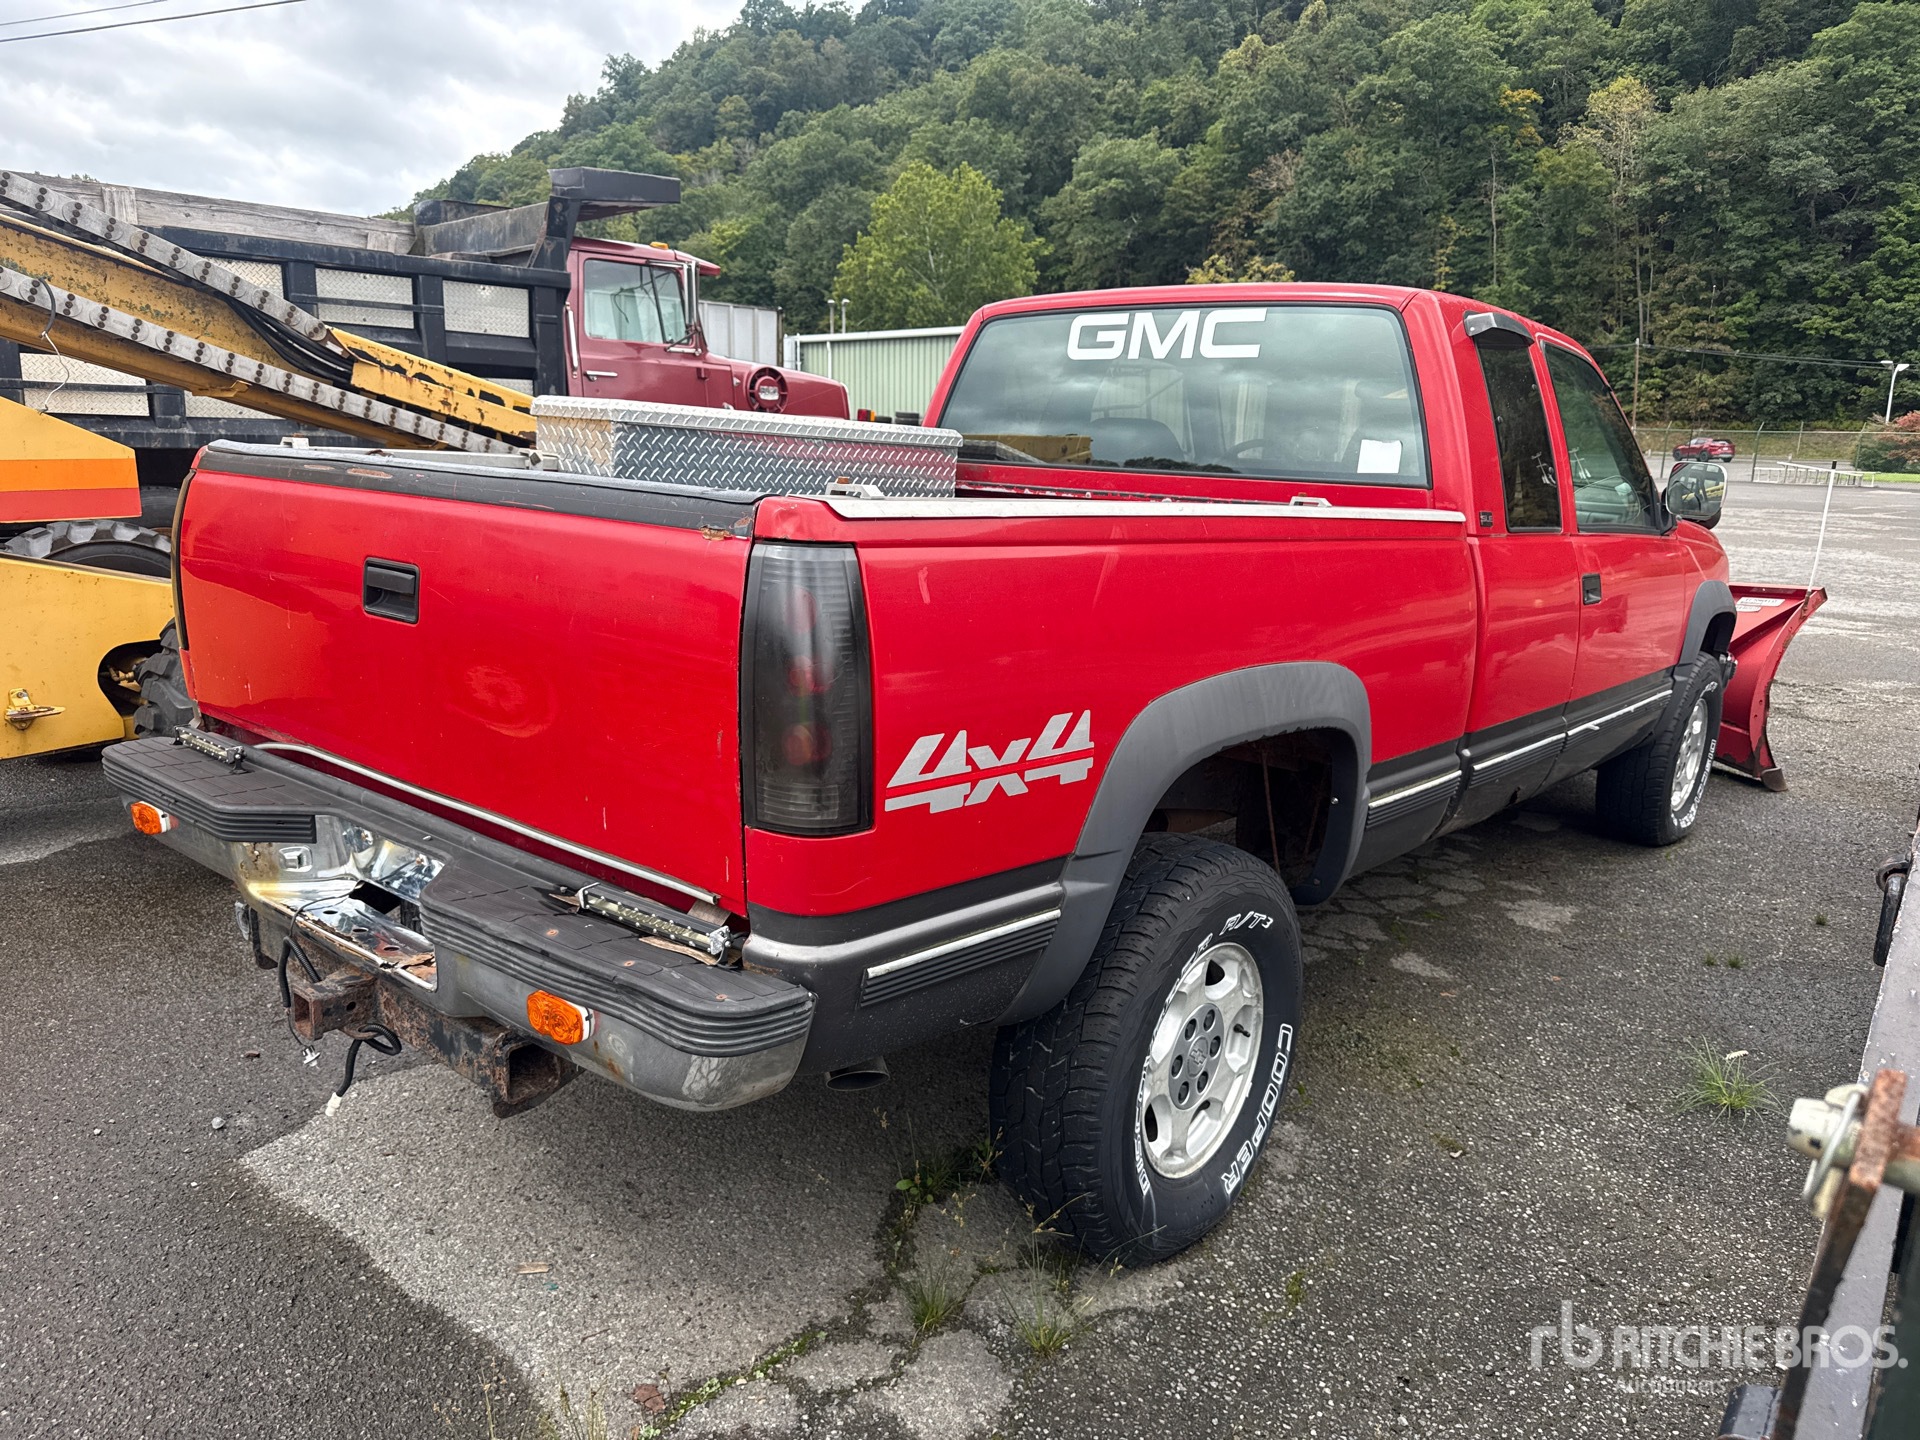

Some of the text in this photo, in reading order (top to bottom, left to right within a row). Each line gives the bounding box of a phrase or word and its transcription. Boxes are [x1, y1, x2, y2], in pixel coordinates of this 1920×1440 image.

[1067, 308, 1267, 360] GMC
[885, 709, 1095, 814] 4x4
[1221, 1023, 1293, 1195] COOPER
